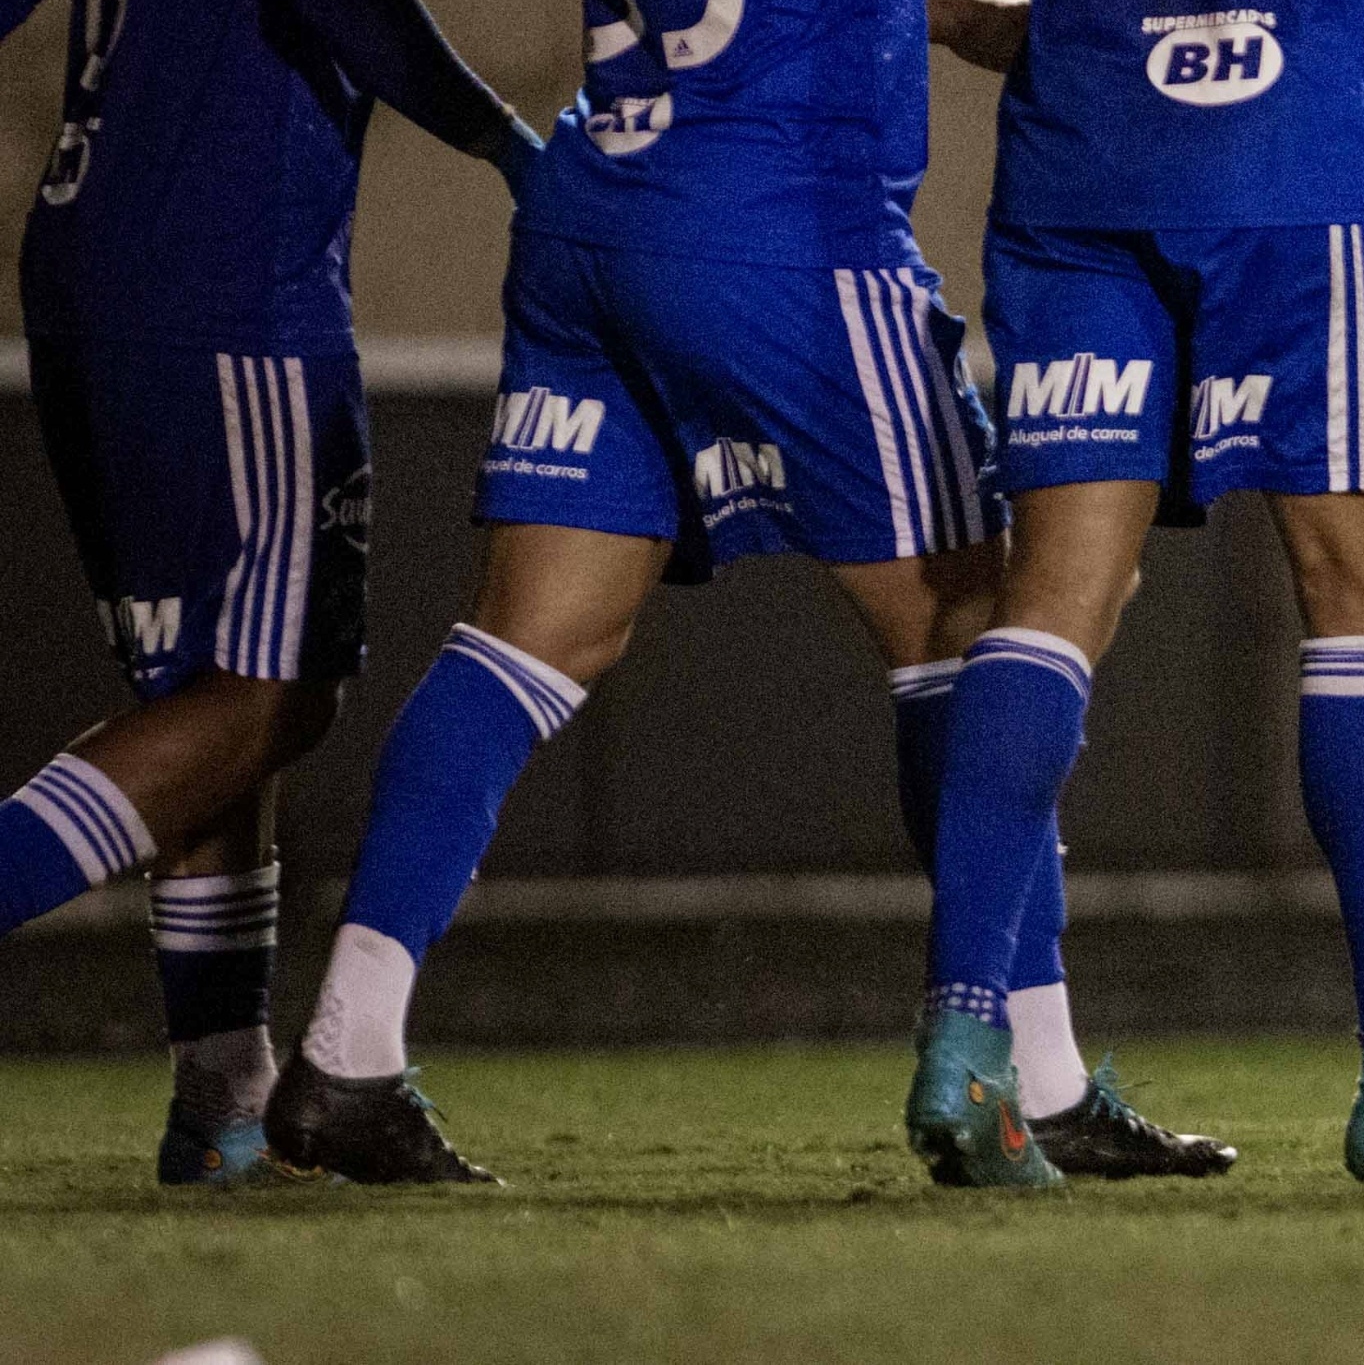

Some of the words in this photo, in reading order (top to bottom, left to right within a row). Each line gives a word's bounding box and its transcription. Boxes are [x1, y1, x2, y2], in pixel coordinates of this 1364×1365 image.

[1162, 36, 1264, 86] BH
[1007, 425, 1065, 448] Aluguel
[1066, 426, 1088, 441] de
[1090, 428, 1140, 441] carros
[535, 464, 588, 481] carros
